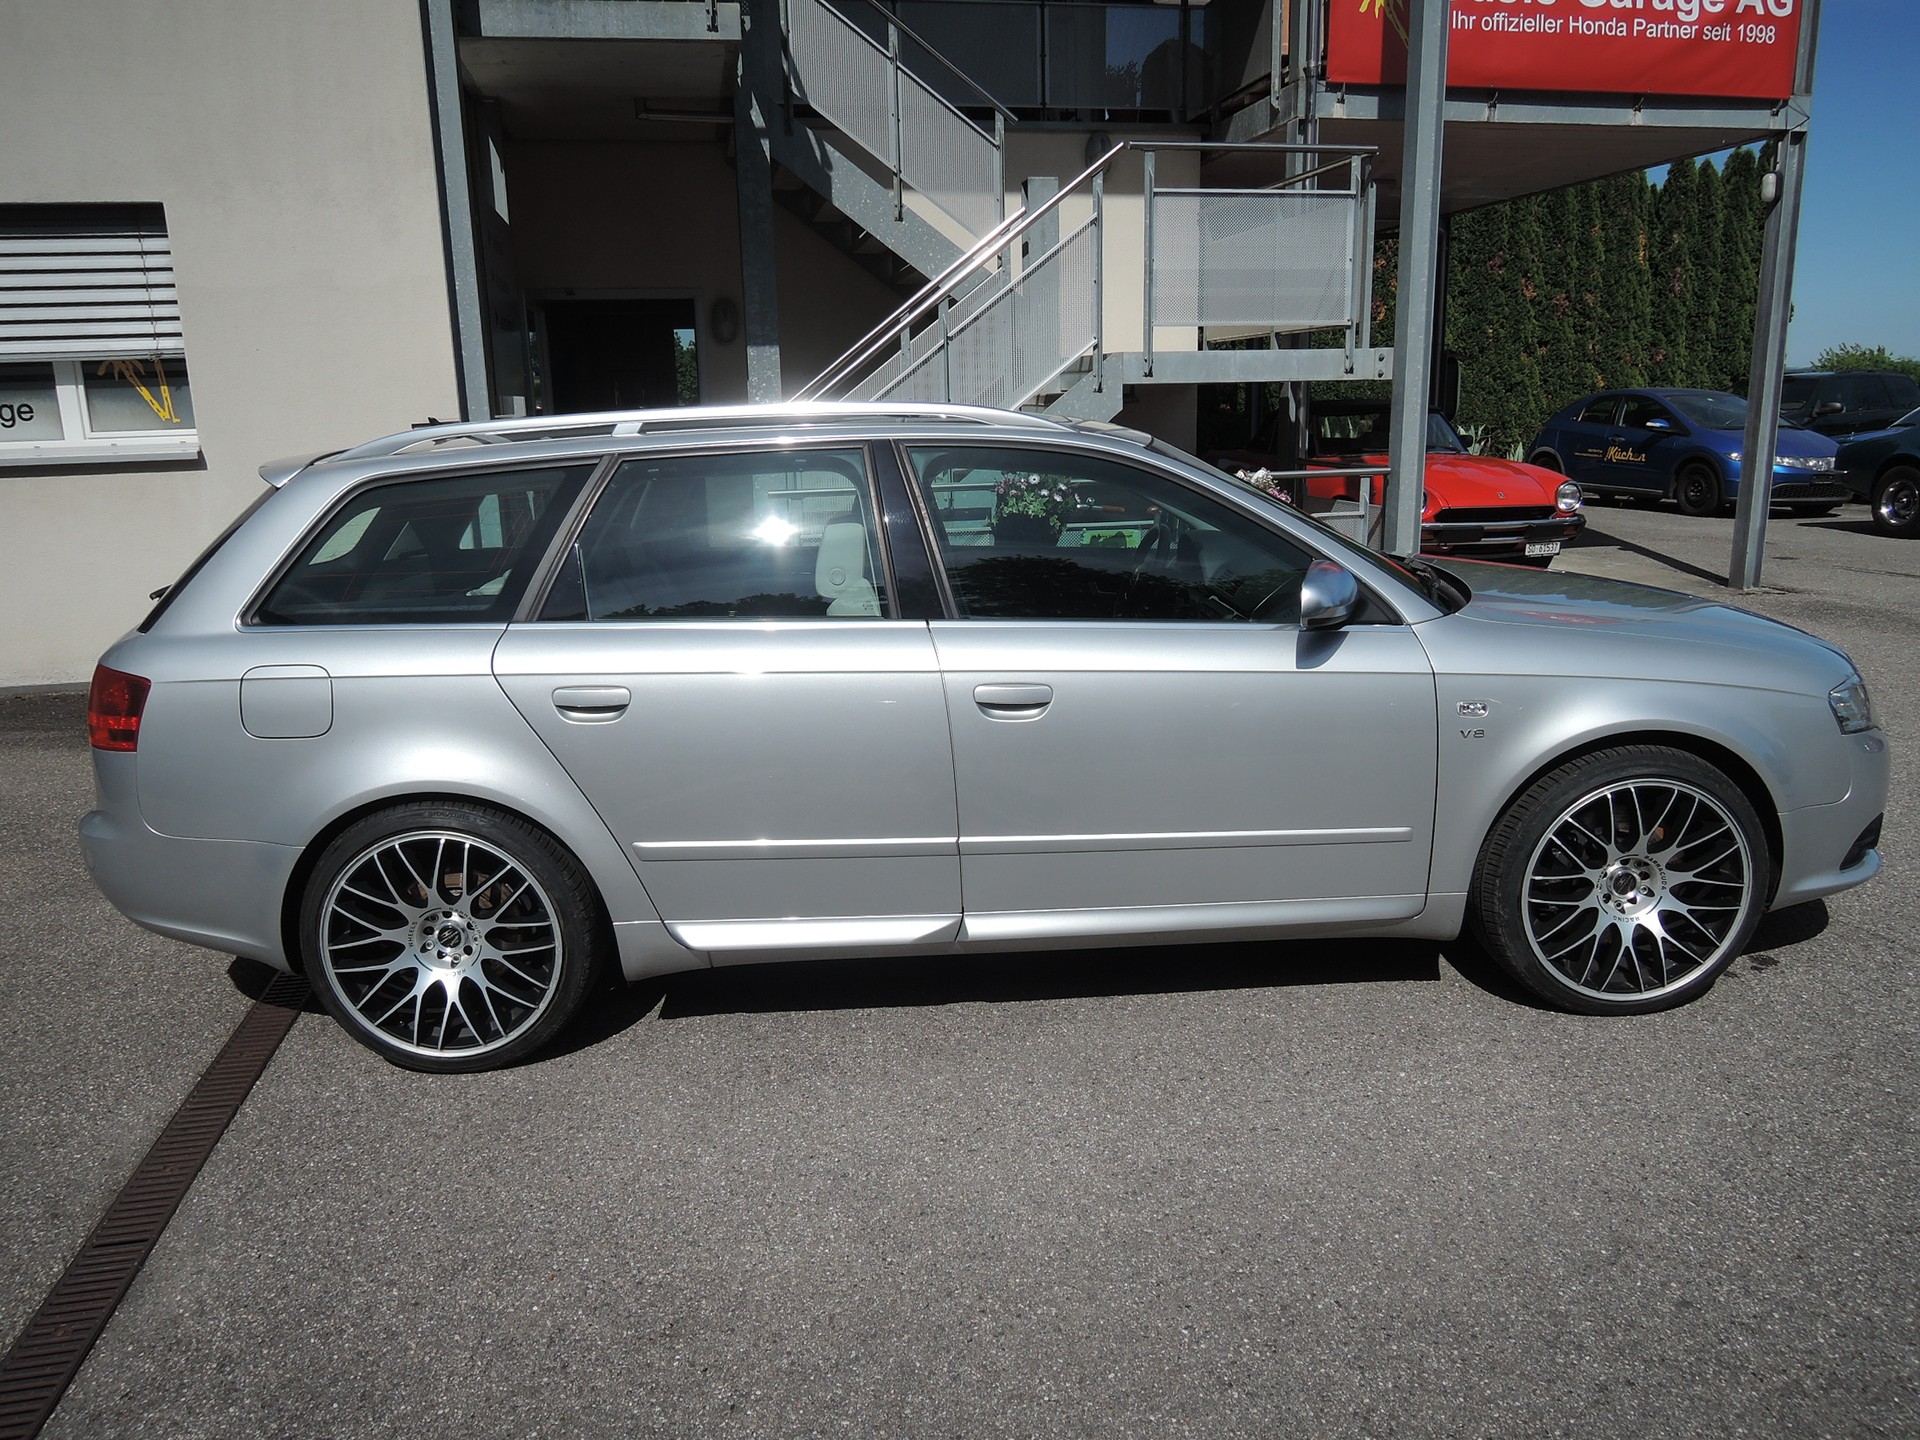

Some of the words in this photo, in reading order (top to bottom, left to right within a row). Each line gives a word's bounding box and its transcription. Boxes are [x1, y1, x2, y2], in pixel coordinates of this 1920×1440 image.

[1452, 10, 1476, 29] Ihr
[1481, 12, 1563, 33] offizieller
[1569, 15, 1627, 36] Honda
[1633, 18, 1698, 39] Partner
[1702, 22, 1731, 42] seit
[1737, 24, 1776, 44] 1998
[1460, 729, 1485, 739] V8
[407, 921, 418, 948] WHEELS
